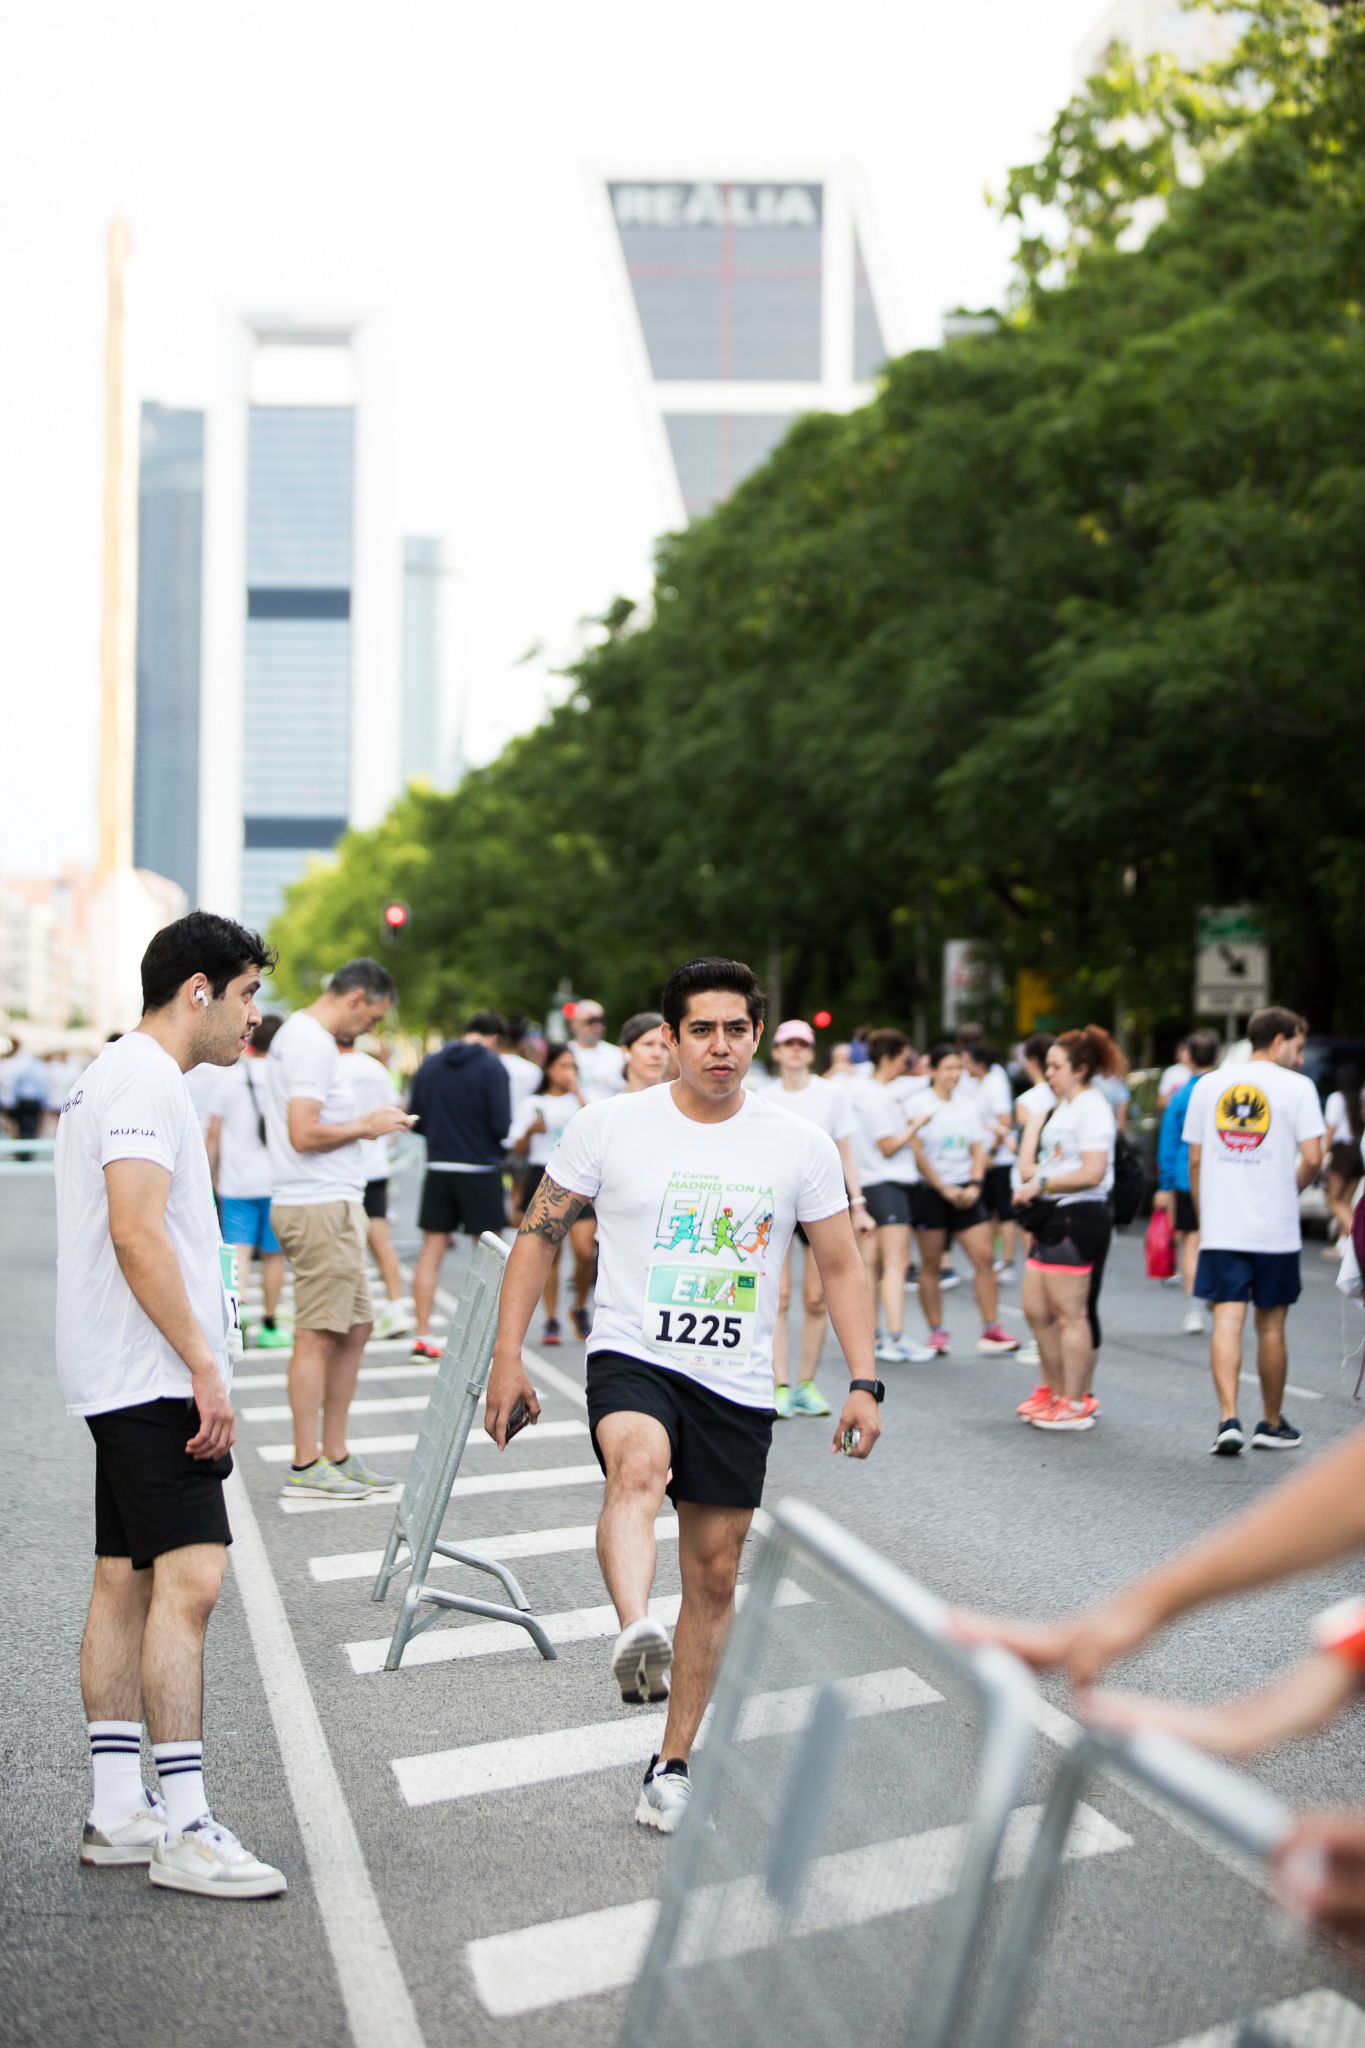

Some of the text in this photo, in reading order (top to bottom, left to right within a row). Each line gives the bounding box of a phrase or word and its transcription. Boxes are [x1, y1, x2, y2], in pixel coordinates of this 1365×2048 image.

[613, 181, 816, 227] REALIA
[667, 1180, 773, 1196] MADRID CON LA
[683, 1172, 720, 1180] Carrera
[655, 1190, 774, 1242] ELA
[671, 1273, 735, 1307] ELA
[655, 1310, 742, 1348] 1225
